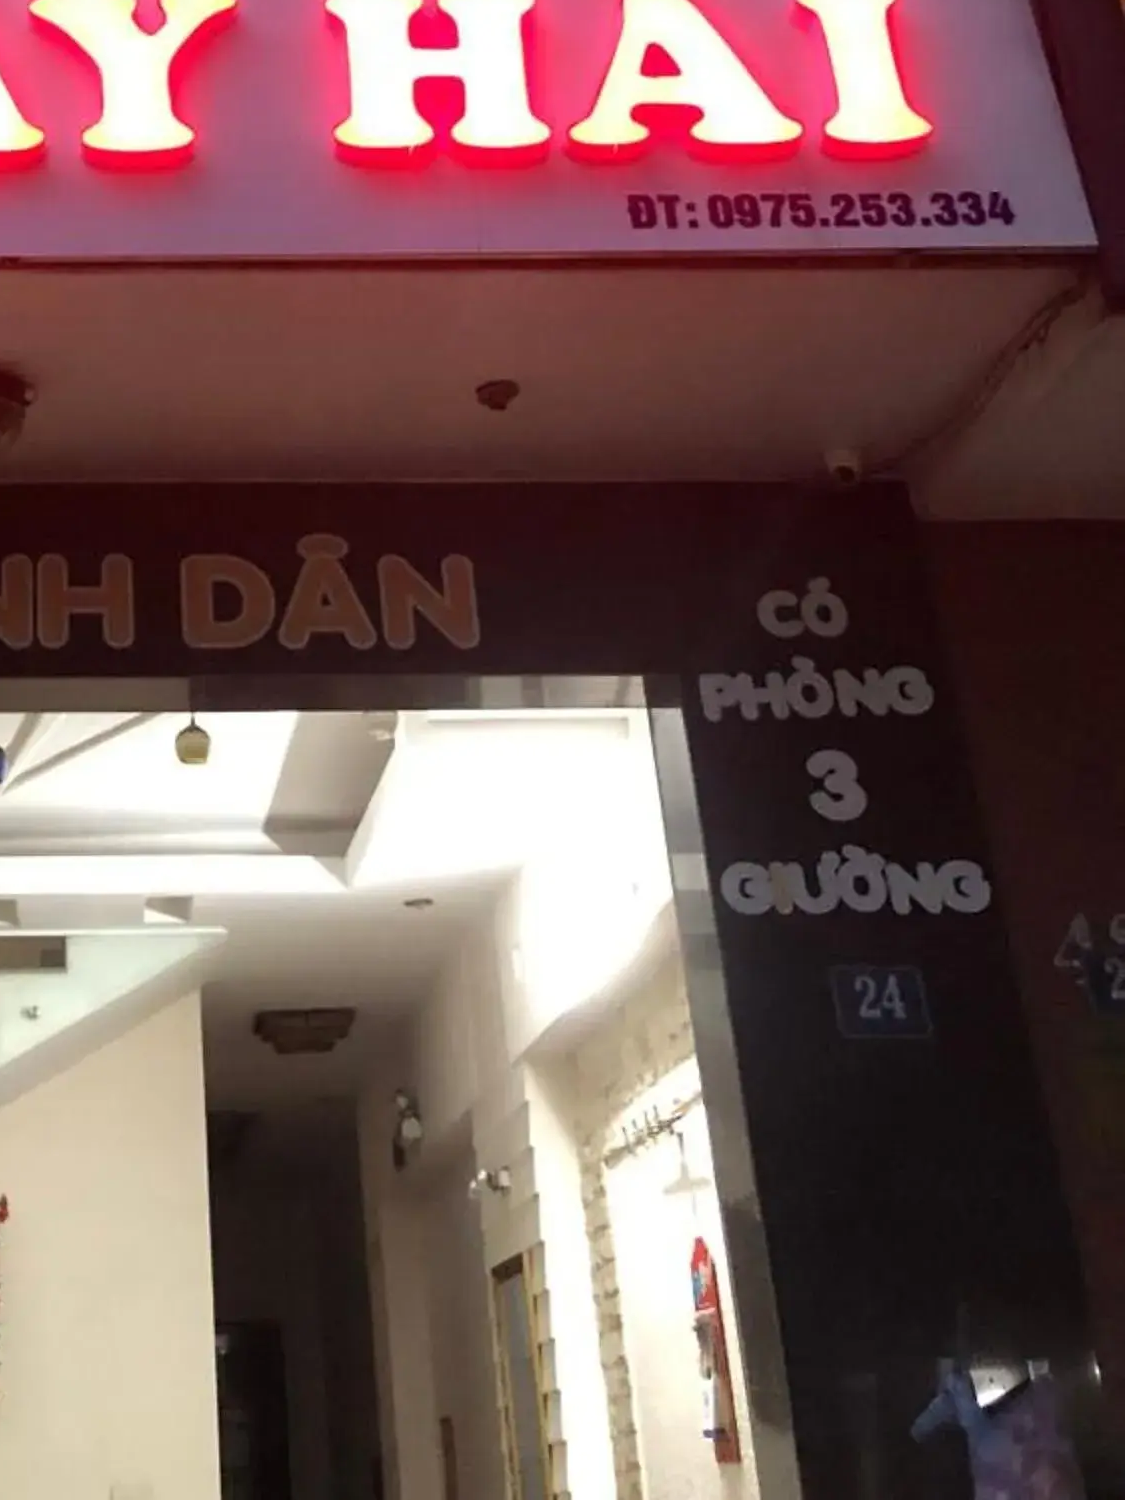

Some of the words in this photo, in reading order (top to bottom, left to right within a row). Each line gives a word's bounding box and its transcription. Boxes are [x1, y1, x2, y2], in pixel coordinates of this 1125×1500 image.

[179, 533, 481, 652] DÂN
[756, 575, 849, 639] CÓ
[697, 655, 936, 723] PHÒNG
[804, 748, 869, 822] 3
[853, 974, 907, 1020] 24
